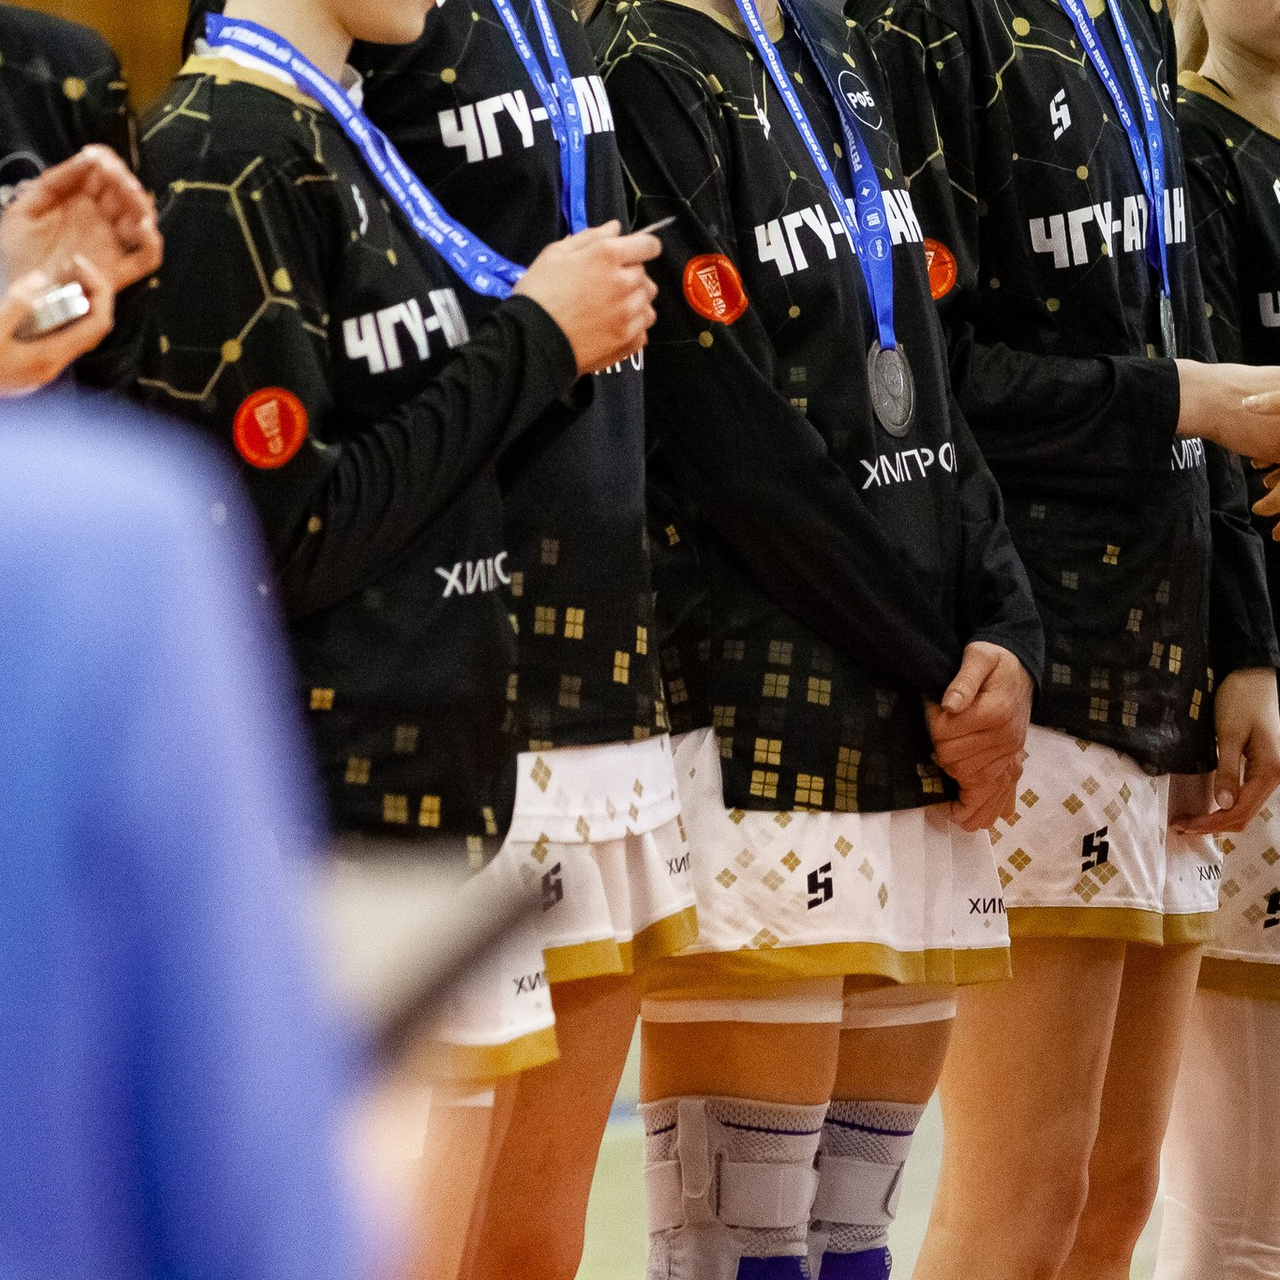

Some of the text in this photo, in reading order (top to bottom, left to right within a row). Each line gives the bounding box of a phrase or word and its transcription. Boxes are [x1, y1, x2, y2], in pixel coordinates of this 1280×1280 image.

[757, 34, 788, 90] ВЫСШАЯ
[784, 90, 803, 121] ЛИГА
[1092, 48, 1110, 78] ЛИГА
[846, 90, 876, 109] РФБ
